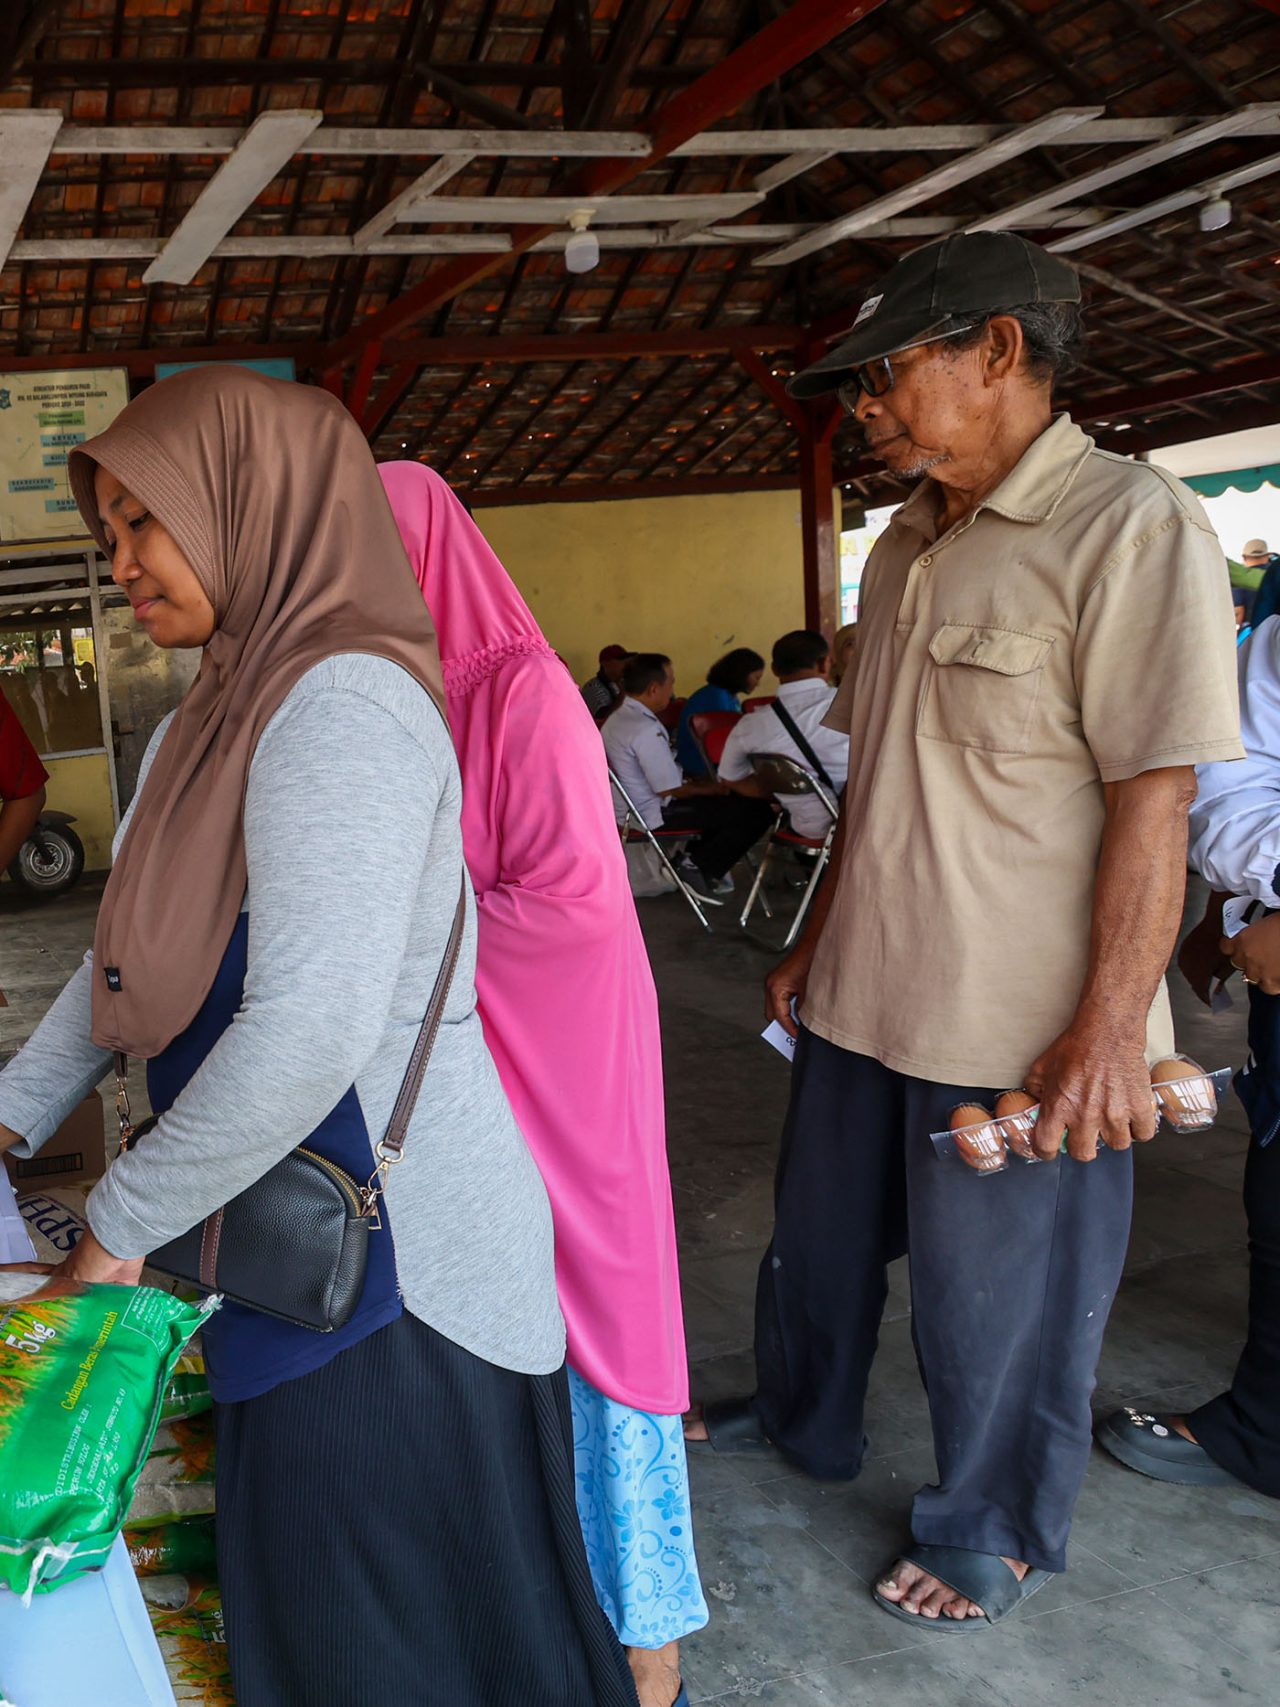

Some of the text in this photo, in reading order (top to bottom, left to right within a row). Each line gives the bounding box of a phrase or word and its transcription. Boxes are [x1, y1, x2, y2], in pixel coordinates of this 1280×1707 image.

[5, 1334, 42, 1354] 5
[24, 1320, 57, 1344] kg
[61, 1371, 89, 1410] Cadangan
[79, 1351, 99, 1372] Beras
